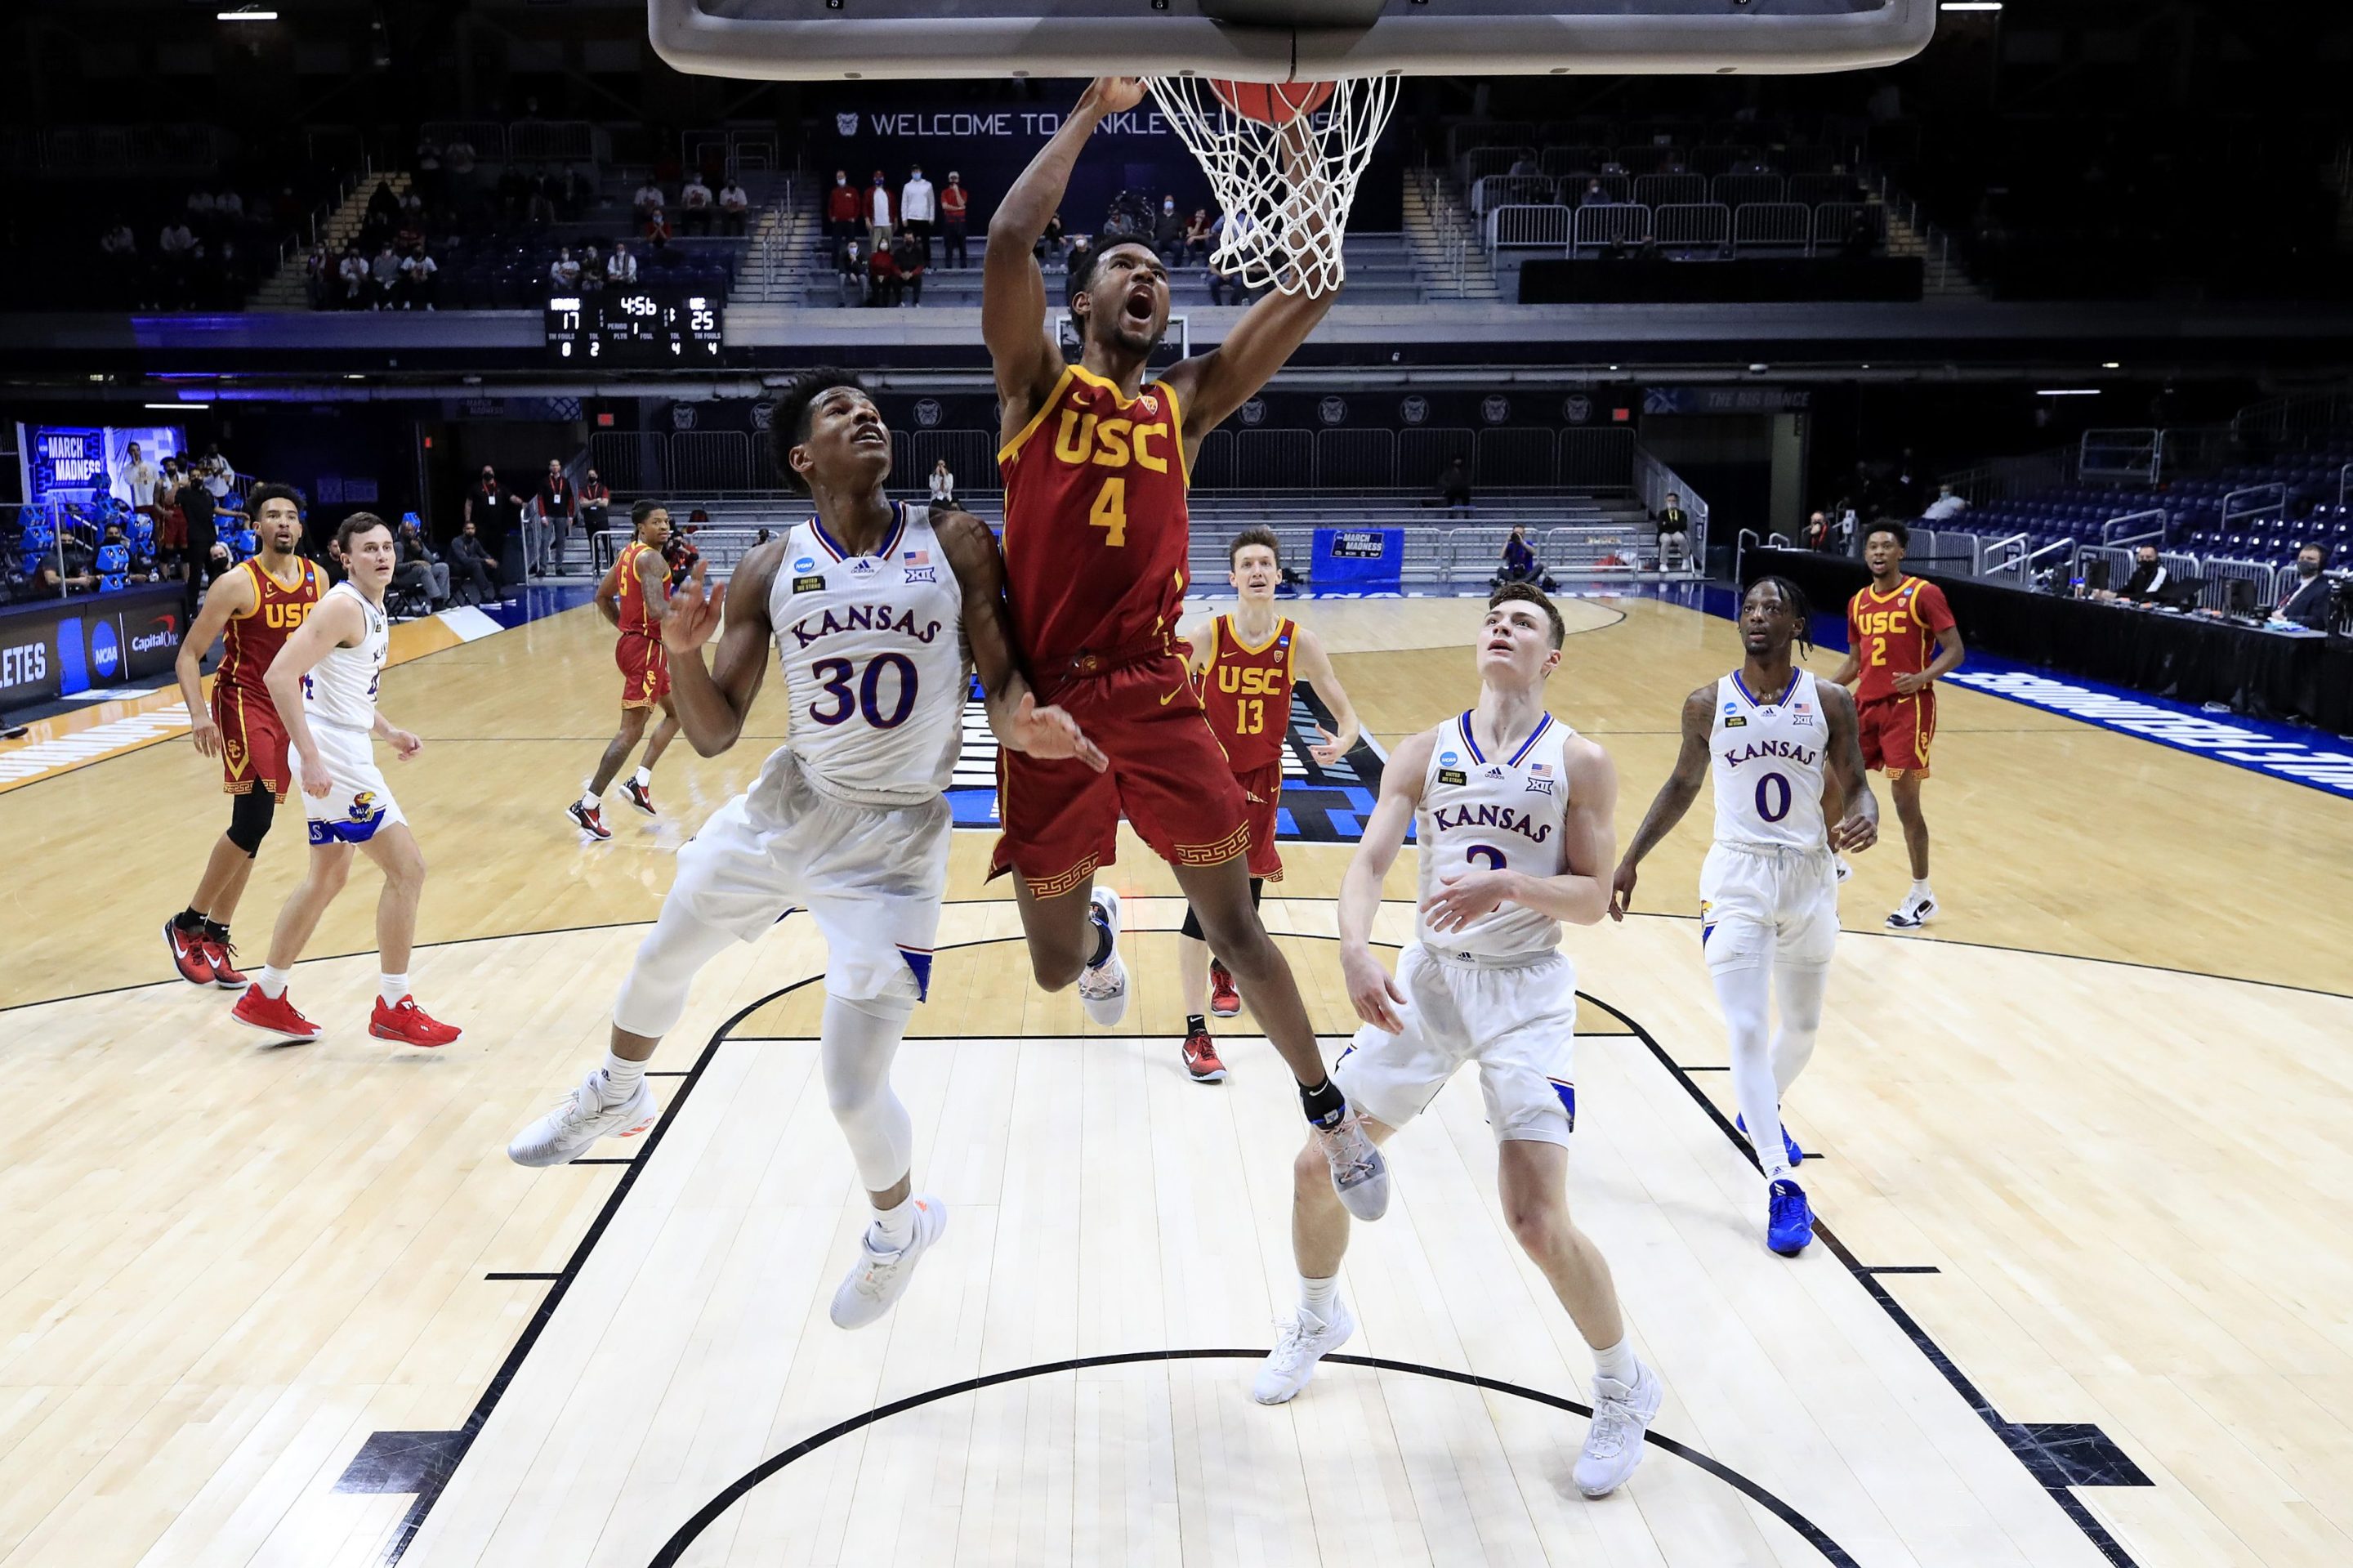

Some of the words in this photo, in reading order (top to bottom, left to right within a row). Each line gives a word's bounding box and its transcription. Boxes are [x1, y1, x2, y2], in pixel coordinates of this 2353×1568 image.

[871, 114, 1012, 136] WELCOME
[1020, 114, 1059, 136] TO
[620, 297, 657, 315] 4:56
[564, 311, 579, 330] 17
[690, 311, 714, 330] 25
[590, 342, 600, 357] 2
[672, 342, 681, 355] 4
[708, 342, 717, 355] 4
[48, 436, 83, 458] MARCH
[1054, 408, 1168, 474] USC
[55, 459, 101, 481] MADNESS
[1089, 476, 1127, 547] 4
[1343, 533, 1371, 543] MARCH
[1346, 542, 1382, 551] MADNESS
[266, 581, 274, 593] C
[791, 605, 942, 649] KANSAS
[1859, 611, 1908, 635] USC
[95, 646, 118, 665] NCAA
[1871, 637, 1886, 666] 2
[0, 642, 46, 689] ETES
[809, 652, 918, 729] 30
[1218, 665, 1283, 695] USC
[1236, 699, 1264, 735] 13
[1724, 740, 1816, 768] KANSAS
[1755, 772, 1792, 823] 0
[1433, 804, 1552, 843] KANSAS
